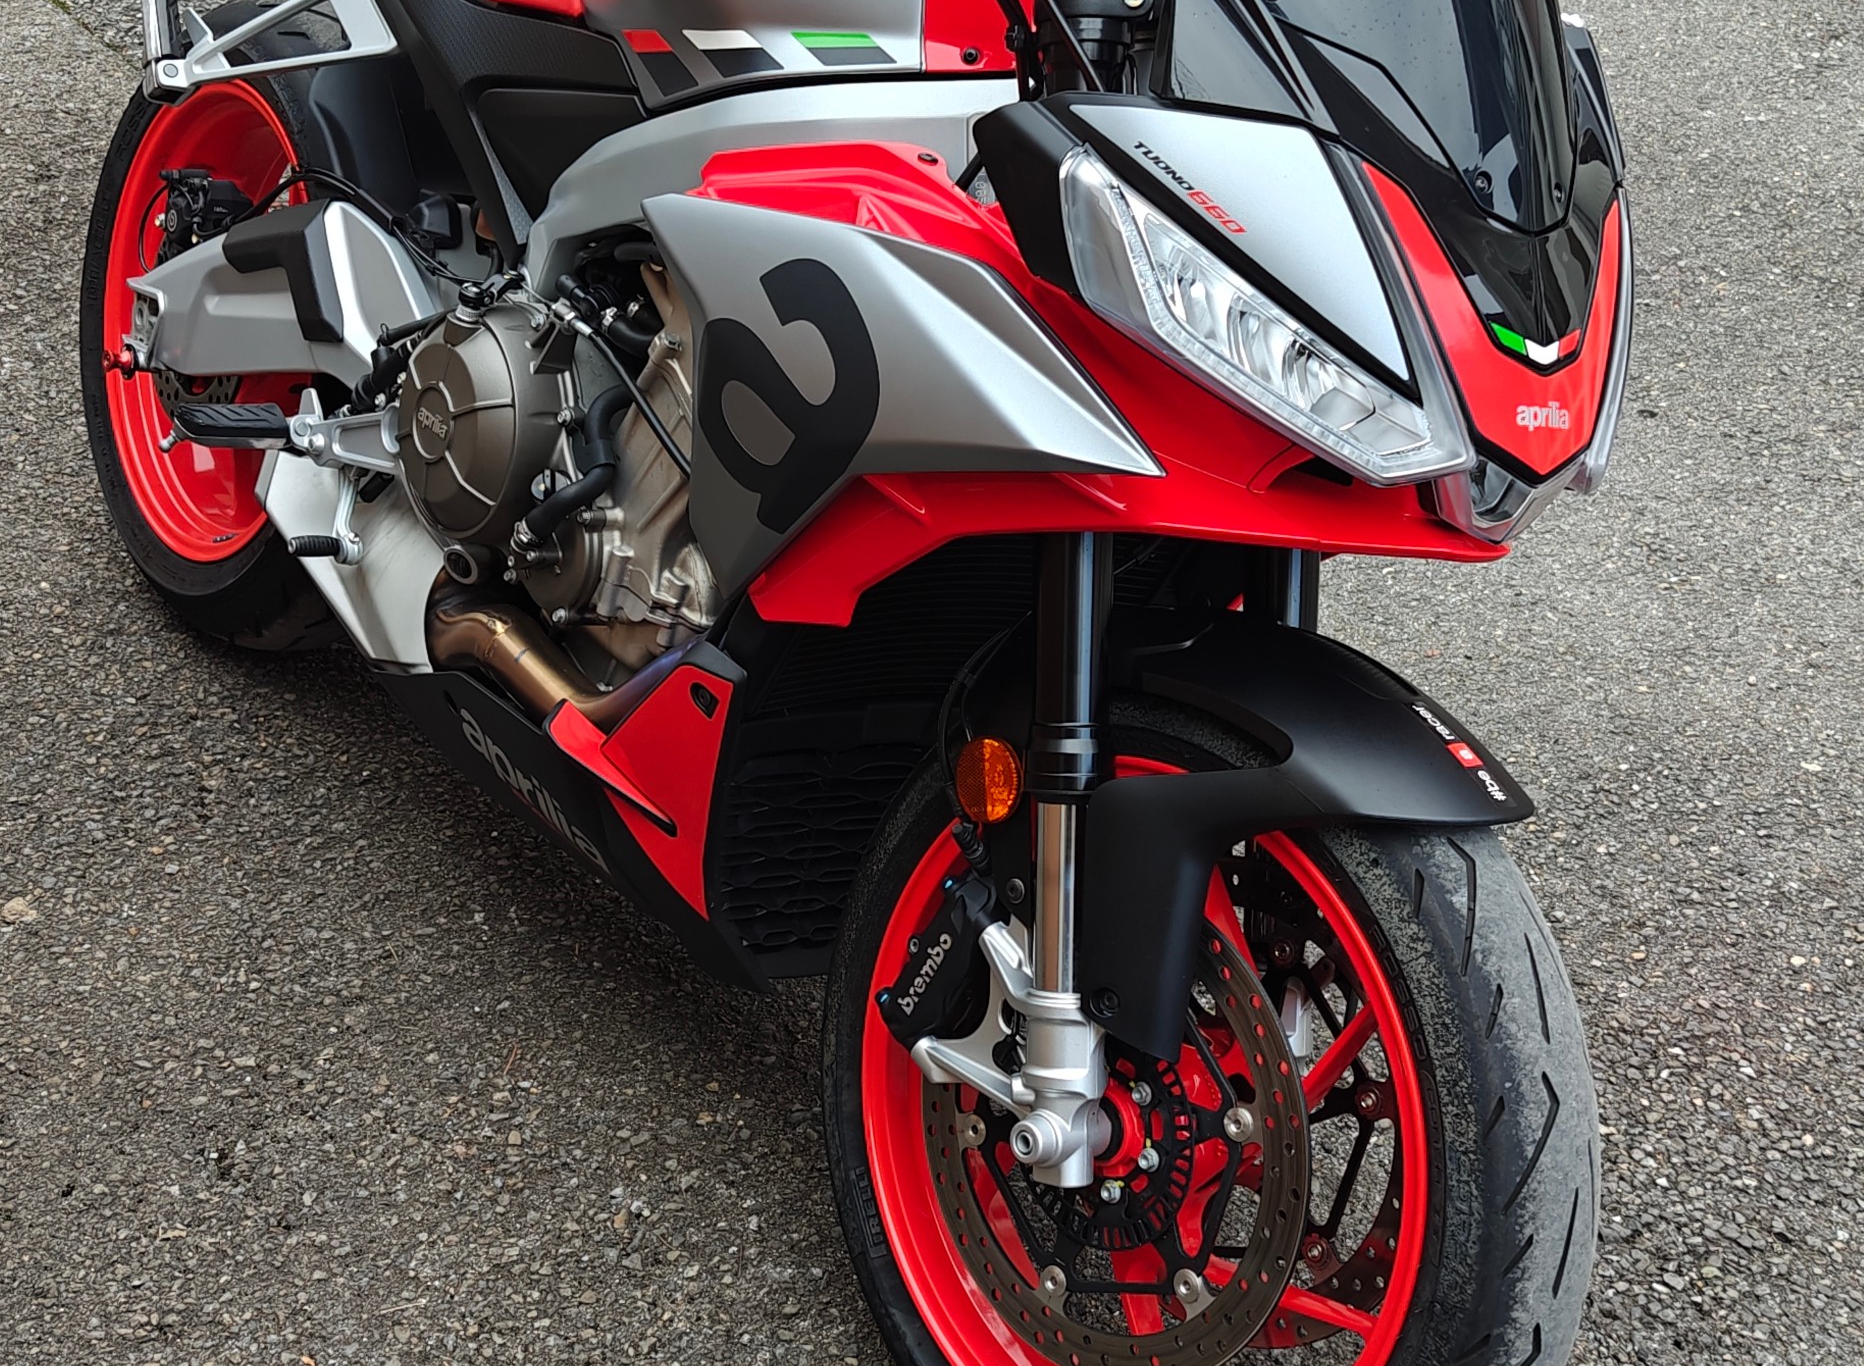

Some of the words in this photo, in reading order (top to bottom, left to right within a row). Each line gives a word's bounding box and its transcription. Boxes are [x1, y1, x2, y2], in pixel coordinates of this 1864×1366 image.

[417, 406, 448, 439] aprilia
[1516, 401, 1569, 432] aprilia
[1411, 704, 1456, 740] racer
[460, 708, 612, 876] aprilia
[897, 933, 952, 1016] brembo
